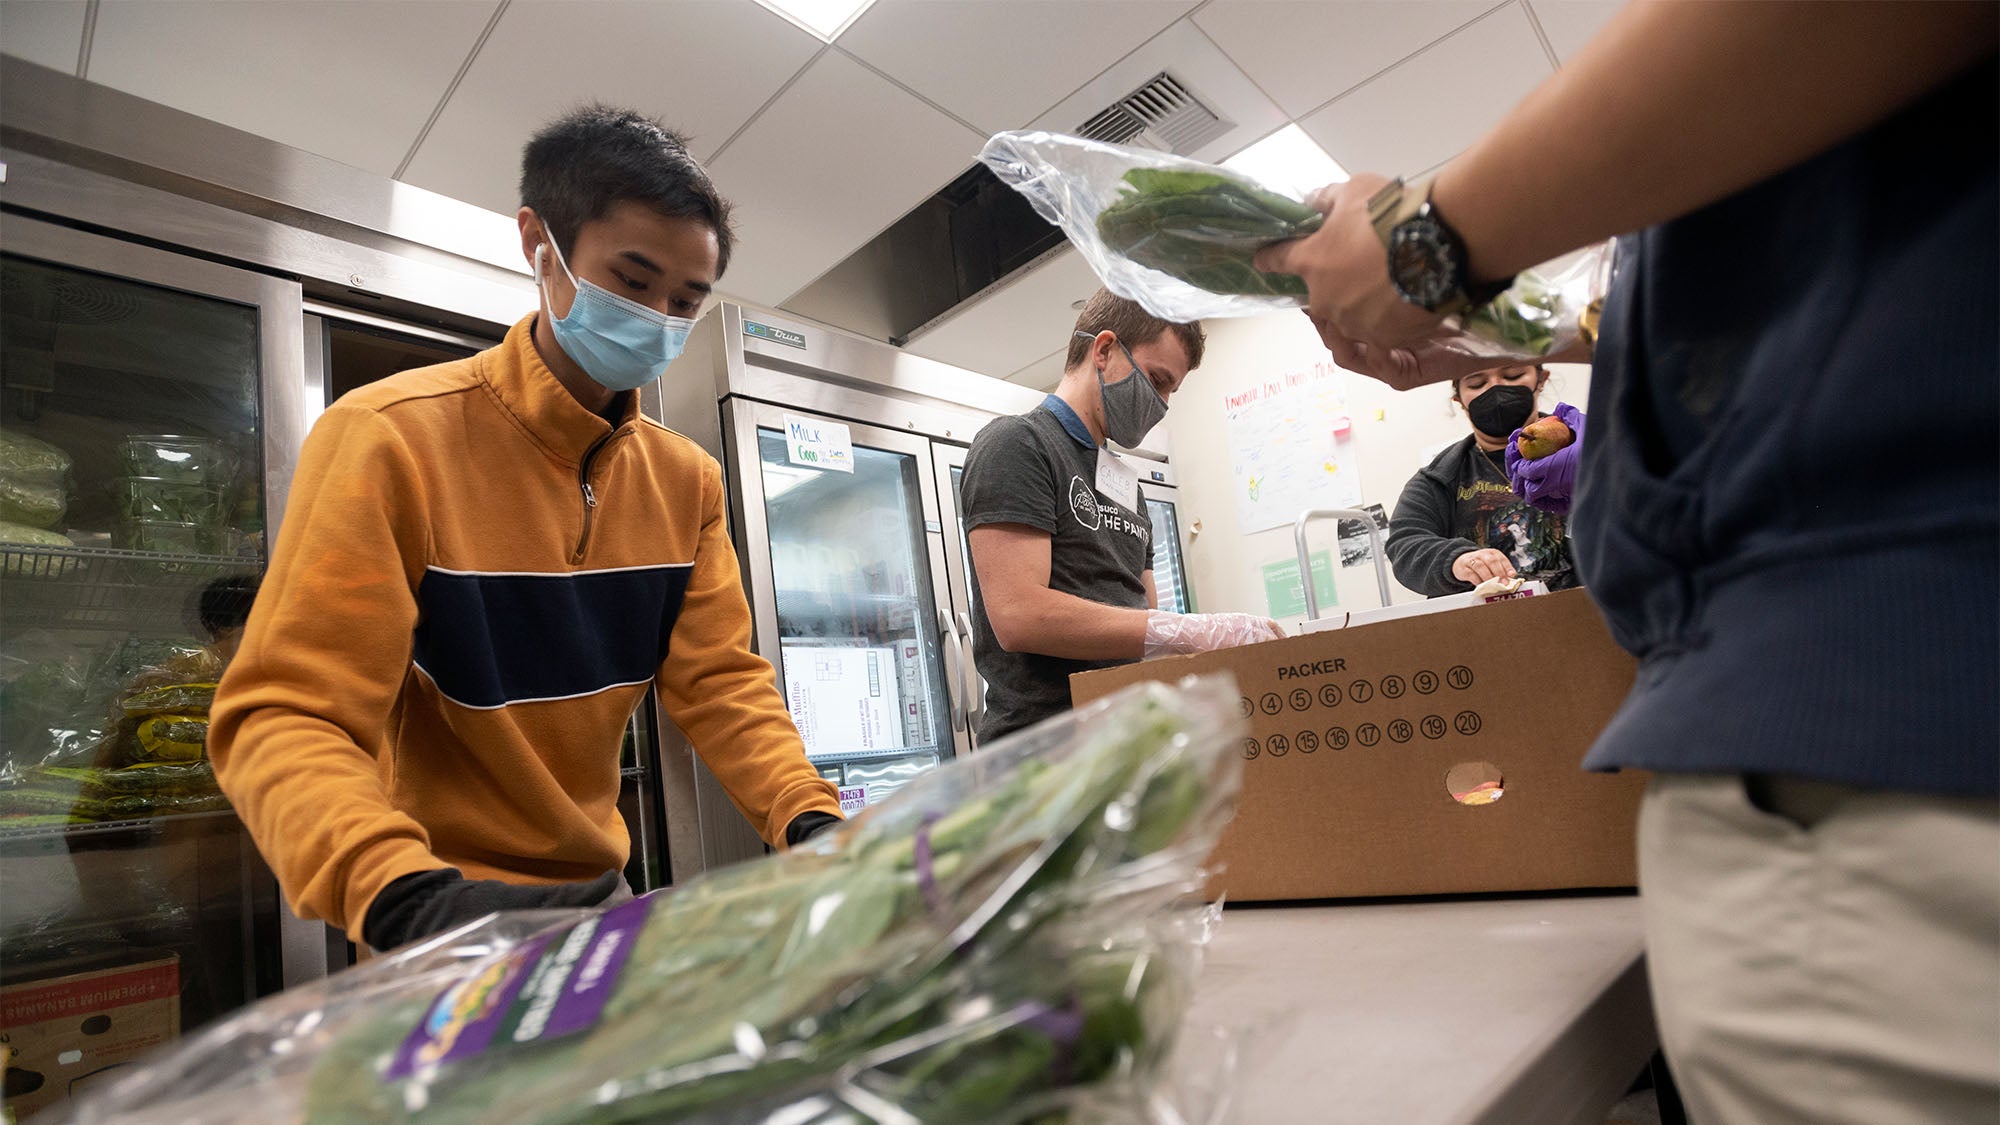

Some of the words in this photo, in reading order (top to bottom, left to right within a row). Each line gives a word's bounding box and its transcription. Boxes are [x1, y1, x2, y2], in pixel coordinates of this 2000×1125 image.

[790, 423, 822, 444] MILK
[1278, 658, 1347, 680] PACKER
[792, 681, 802, 716] Muffins
[81, 984, 147, 1007] PREMIUM
[6, 998, 77, 1019] BANANAS
